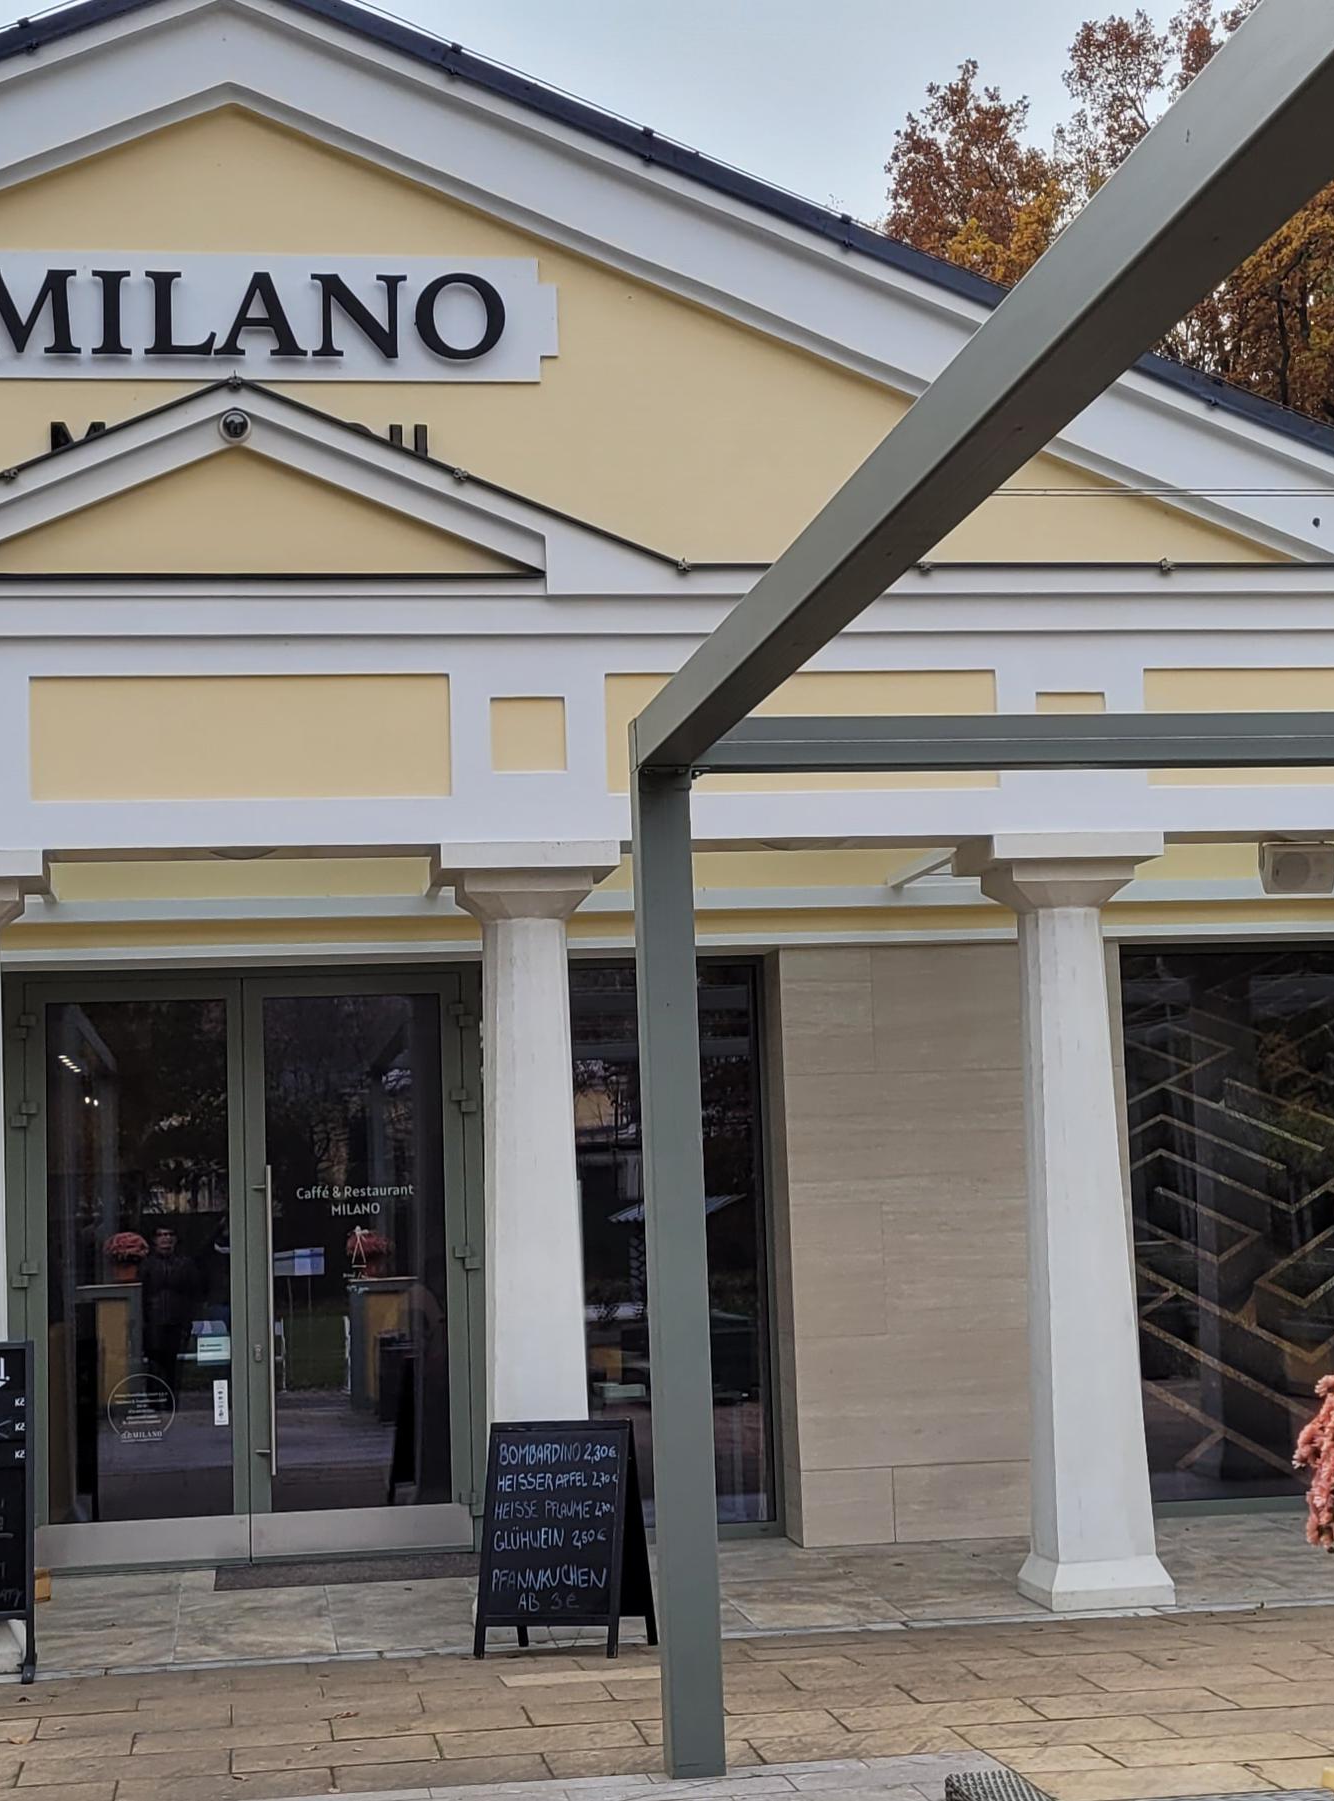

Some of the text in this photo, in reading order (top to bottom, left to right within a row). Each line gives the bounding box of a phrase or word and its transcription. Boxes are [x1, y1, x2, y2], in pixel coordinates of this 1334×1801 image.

[296, 1183, 415, 1200] Caffé & Restaurant
[331, 1203, 381, 1216] MILANO
[499, 1442, 581, 1466] BOMBARDINO
[497, 1473, 554, 1492] HEISSER
[555, 1471, 588, 1489] APFEL
[494, 1500, 539, 1521] HEISSE
[545, 1500, 593, 1519] PFLAUME
[493, 1526, 565, 1551] GLÜHWEIN
[491, 1564, 607, 1592] PFANNKUCHEN
[517, 1592, 540, 1612] AB
